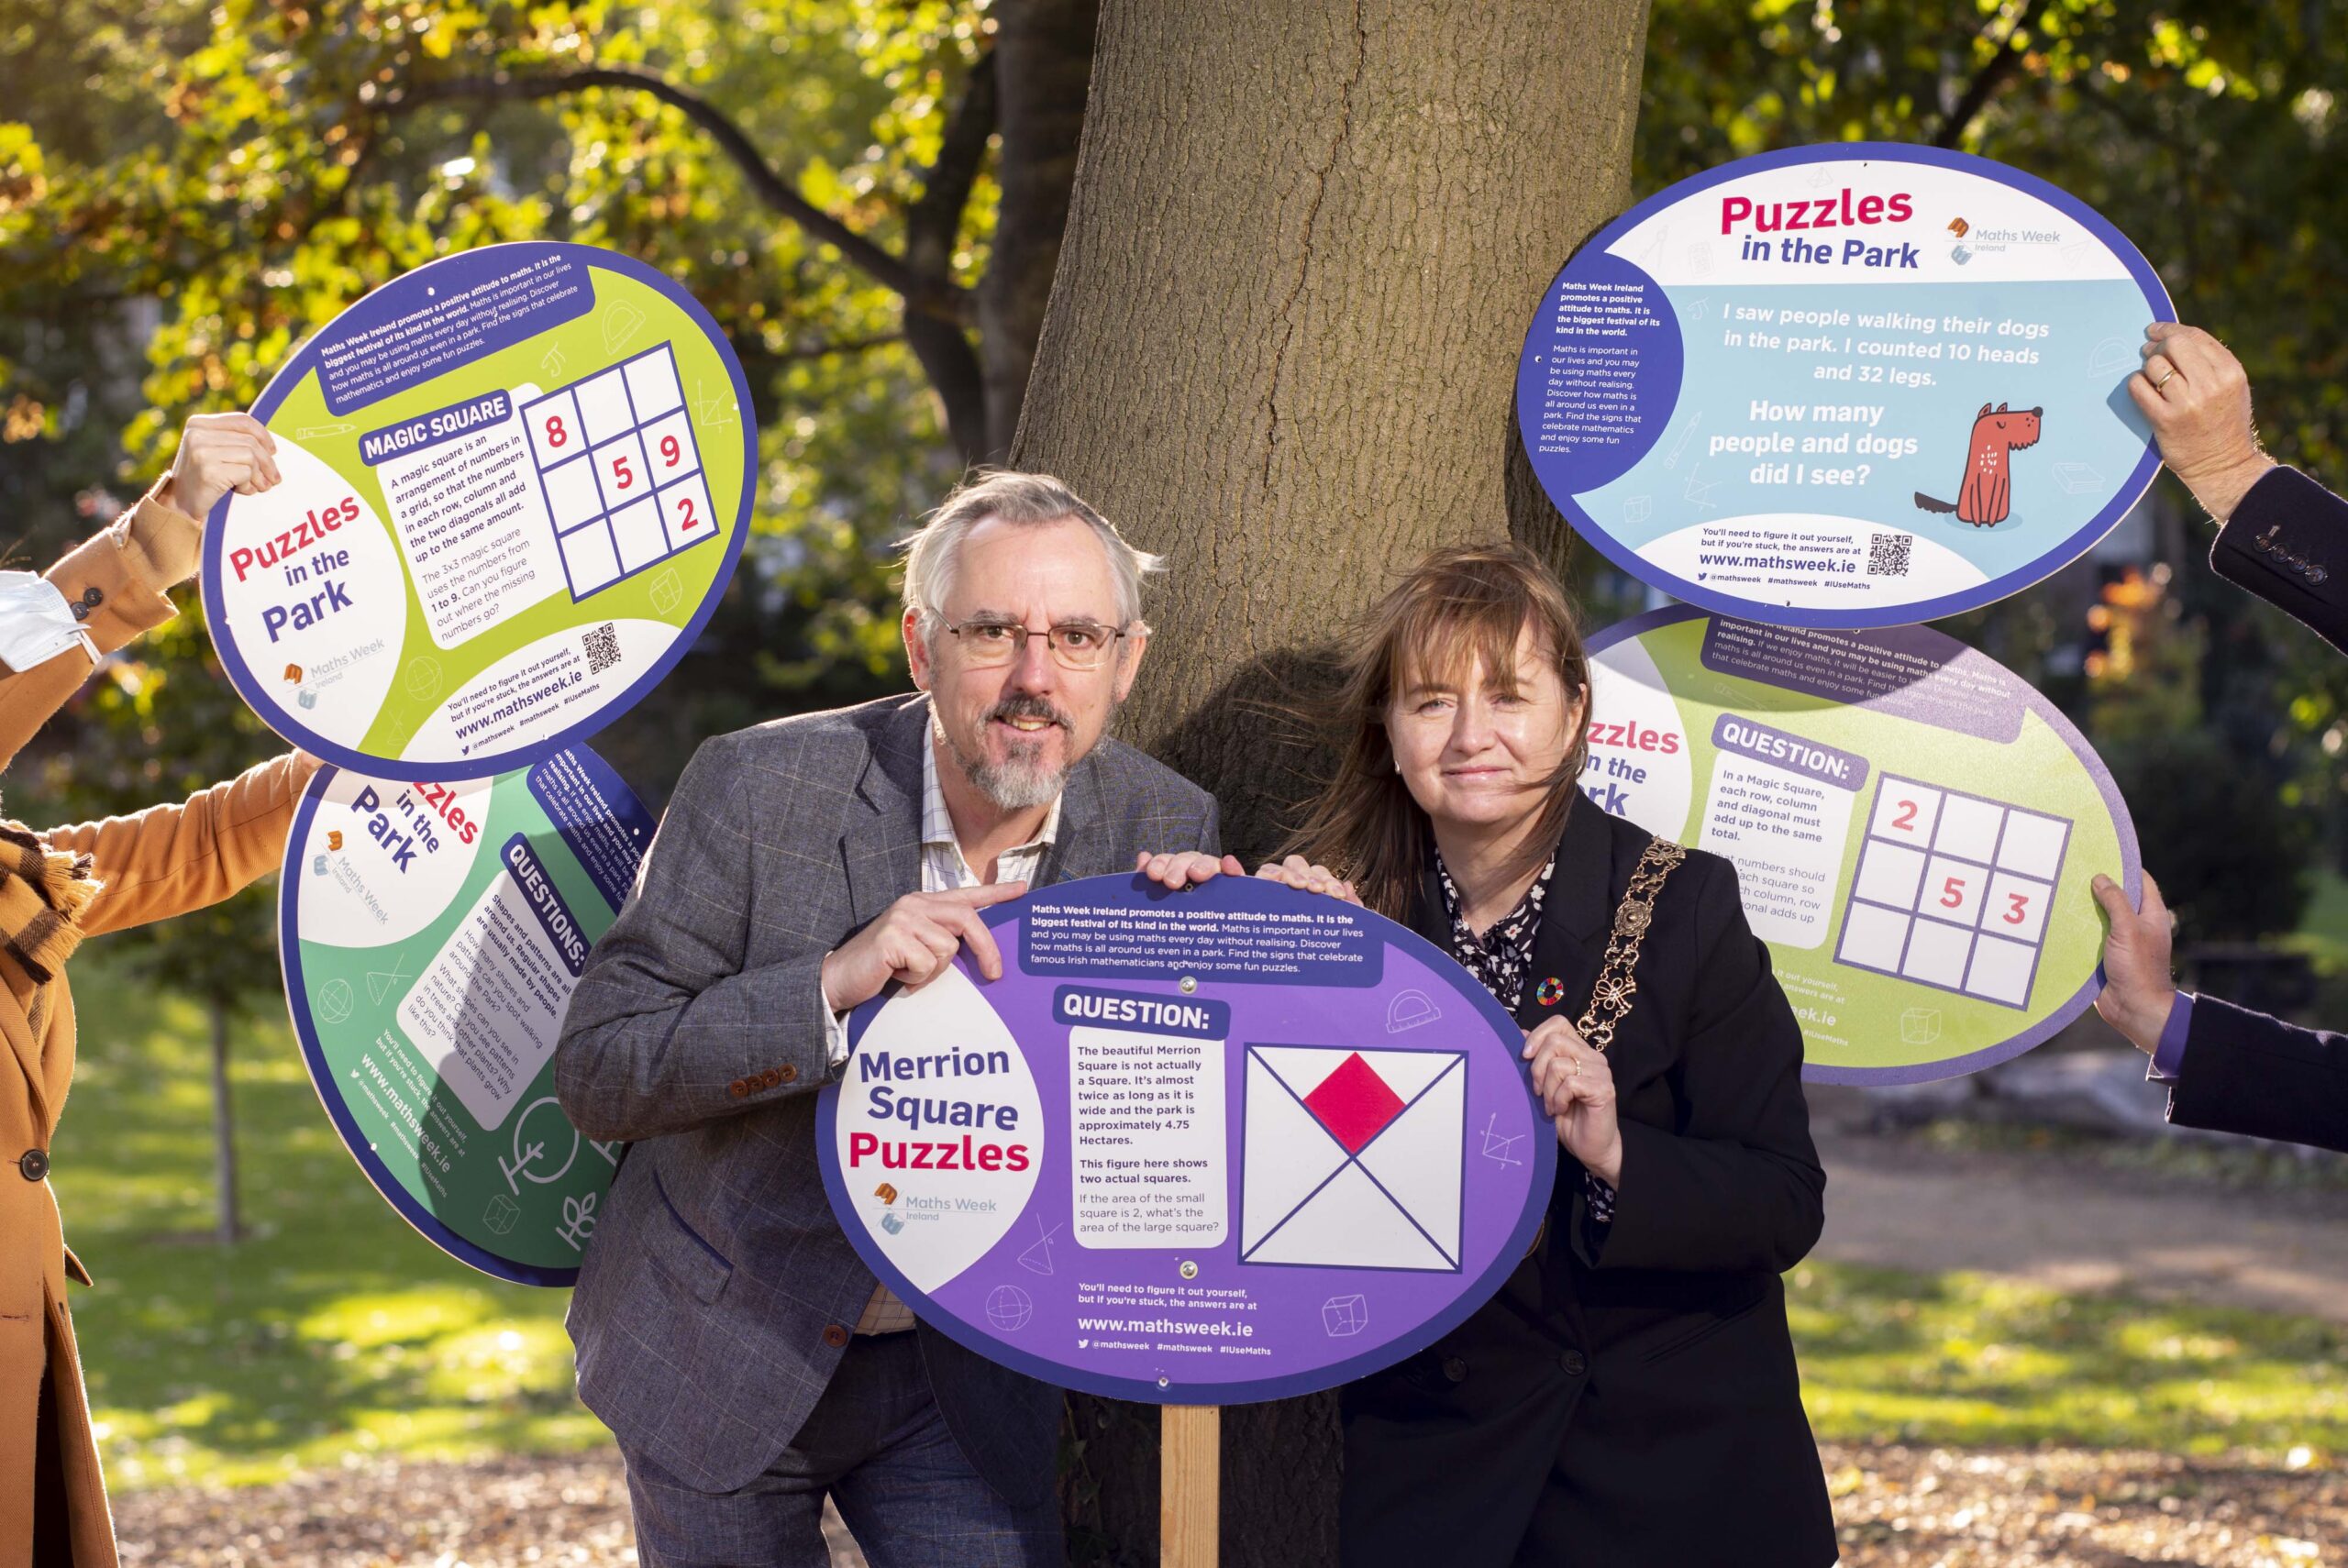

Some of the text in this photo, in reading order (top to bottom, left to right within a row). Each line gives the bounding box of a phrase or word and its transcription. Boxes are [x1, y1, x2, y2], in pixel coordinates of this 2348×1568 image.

[1721, 187, 1912, 235] Puzzles
[1742, 234, 1920, 268] in the Park
[1976, 229, 2061, 242] Maths Week
[1562, 282, 1586, 290] Maths
[1723, 303, 2049, 339] I saw people walking their dogs
[1723, 329, 2039, 364] in the park. I counted 10 heads
[1813, 364, 1936, 387] and 32 legs.
[364, 396, 507, 458] MAGIC SQUARE
[1749, 400, 1884, 426] How many
[545, 415, 567, 447] 8
[1709, 431, 1917, 458] people and dogs
[391, 436, 486, 489] A magic square is an
[659, 435, 680, 467] 9
[612, 455, 633, 489] 5
[1750, 462, 1870, 485] did I see?
[677, 497, 698, 531] 2
[229, 496, 360, 582] Puzzles
[283, 549, 349, 586] in the
[421, 528, 520, 583] The 3x3 magic square
[1700, 554, 1855, 572] www.mathsweek.ie
[261, 581, 352, 643] Park
[441, 603, 499, 641] numbers go?
[311, 638, 385, 679] Maths Week
[455, 671, 581, 739] www.mathsweek.ie
[1722, 723, 1850, 778] QUESTION:
[1608, 757, 1646, 784] the
[1722, 769, 1733, 779] In
[1746, 774, 1779, 789] Magic
[1782, 781, 1823, 800] Square,
[1716, 800, 1820, 827] and diagonal must
[1720, 786, 1817, 812] each row, column
[350, 784, 417, 875] Park
[395, 790, 439, 854] in the
[1713, 813, 1822, 842] add up to the same
[1891, 800, 1917, 831] 2
[1711, 827, 1739, 840] total.
[338, 856, 389, 925] Maths Week
[509, 844, 585, 968] QUESTIONS:
[1939, 877, 1966, 908] 5
[1032, 904, 1059, 913] Maths
[1061, 906, 1090, 914] Week
[1092, 907, 1126, 915] Ireland
[1129, 909, 1175, 917] promotes
[1186, 910, 1224, 919] positive
[1226, 911, 1266, 921] attitude
[1281, 913, 1313, 922] maths.
[1316, 914, 1324, 922] It
[1326, 914, 1335, 923] is
[1336, 915, 1353, 923] the
[2002, 892, 2029, 924] 3
[408, 1005, 437, 1038] like this?
[1064, 994, 1209, 1029] QUESTION:
[858, 1046, 1009, 1082] Merrion
[1077, 1045, 1201, 1055] The beautiful Merrion
[1078, 1060, 1201, 1072] Square is not actually
[1078, 1090, 1109, 1099] twice
[1128, 1090, 1154, 1101] long
[1173, 1090, 1180, 1099] it
[1185, 1090, 1193, 1099] is
[1088, 1076, 1131, 1087] Square.
[1155, 1076, 1193, 1084] almost
[360, 1053, 451, 1174] www.mathsweek.ie
[867, 1086, 1018, 1131] Square
[1079, 1105, 1194, 1115] wide and the park is
[1079, 1120, 1189, 1132] approximately 4.75
[1080, 1136, 1133, 1144] Hectares.
[849, 1132, 1030, 1171] Puzzles
[905, 1196, 997, 1211] Maths Week
[1078, 1318, 1252, 1336] www.mathsweek.ie
